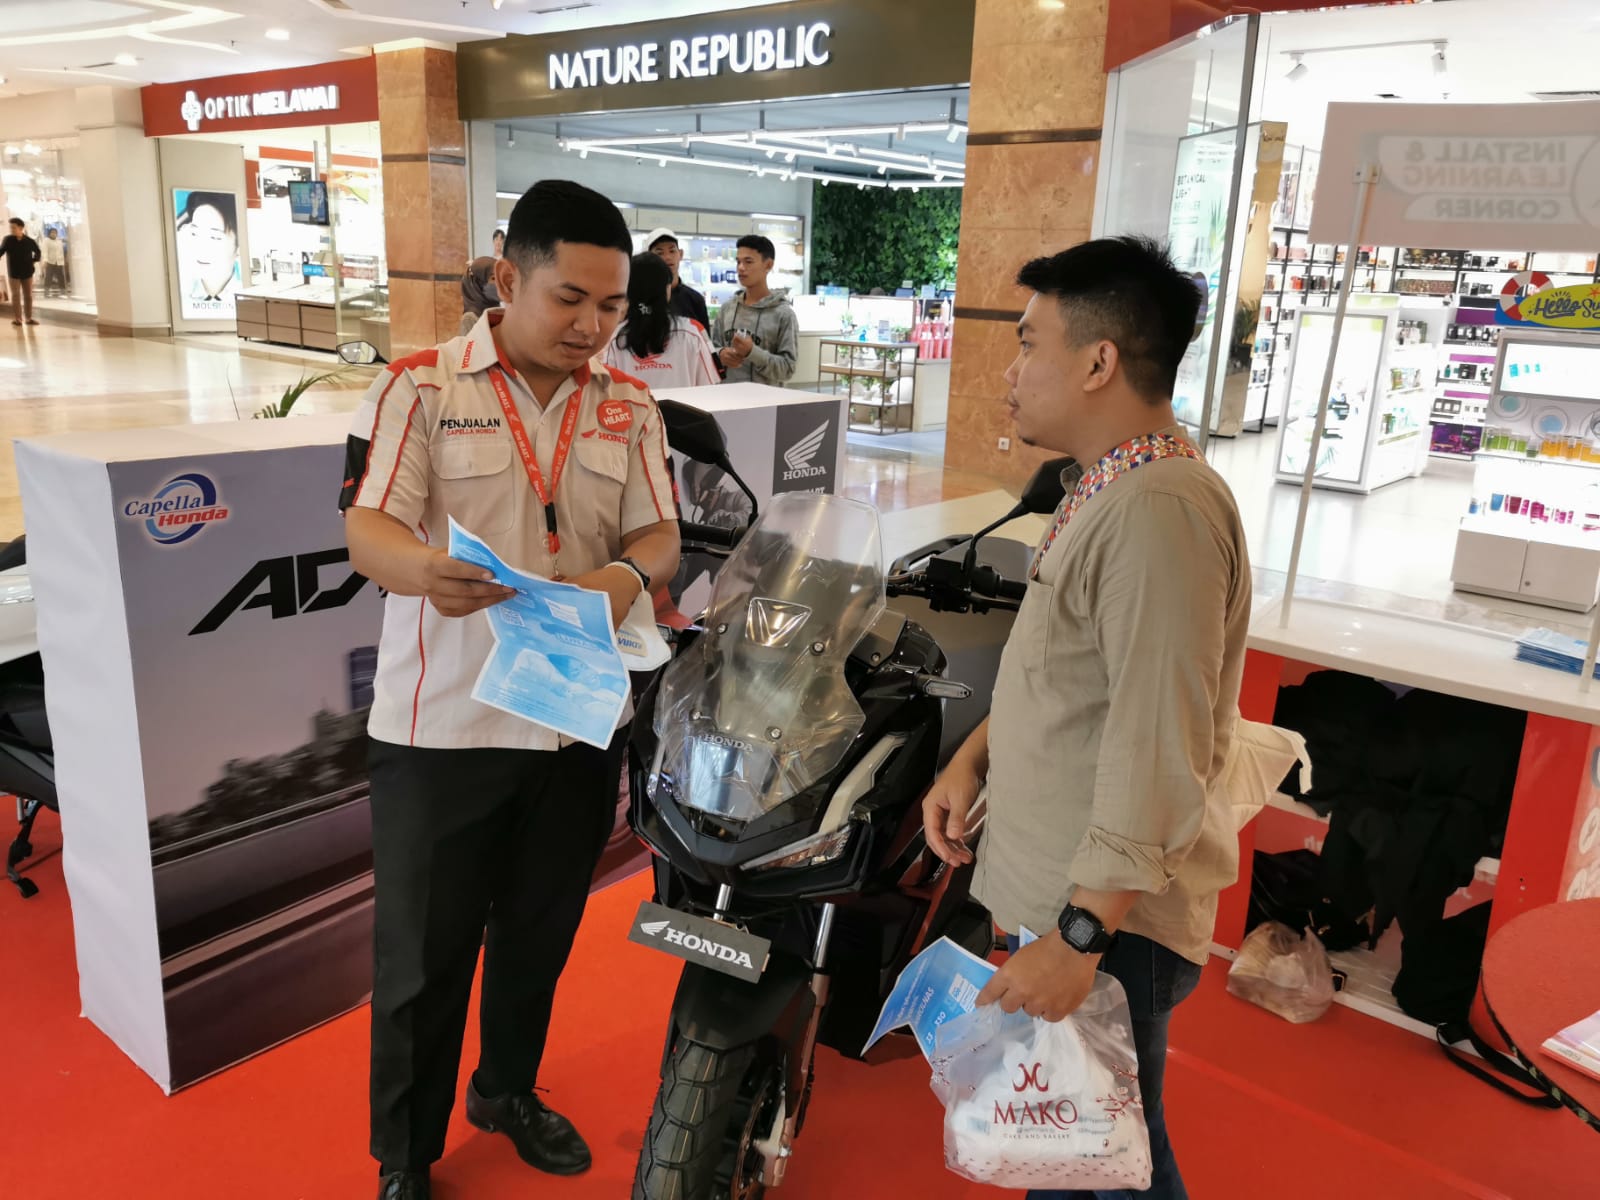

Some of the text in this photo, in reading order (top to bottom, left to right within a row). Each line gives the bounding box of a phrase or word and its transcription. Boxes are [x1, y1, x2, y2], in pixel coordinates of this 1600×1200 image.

[549, 22, 831, 90] NATURE REPUBLIC
[204, 85, 339, 120] OPTIK MELAWAI
[1533, 297, 1581, 319] Hello
[606, 407, 622, 415] One
[440, 417, 500, 430] PENJUALAN
[783, 466, 827, 480] HONDA
[124, 495, 201, 518] Capella
[158, 508, 228, 527] Honda
[703, 733, 753, 752] HONDA
[663, 927, 753, 969] HONDA
[994, 1100, 1077, 1130] MAKO
